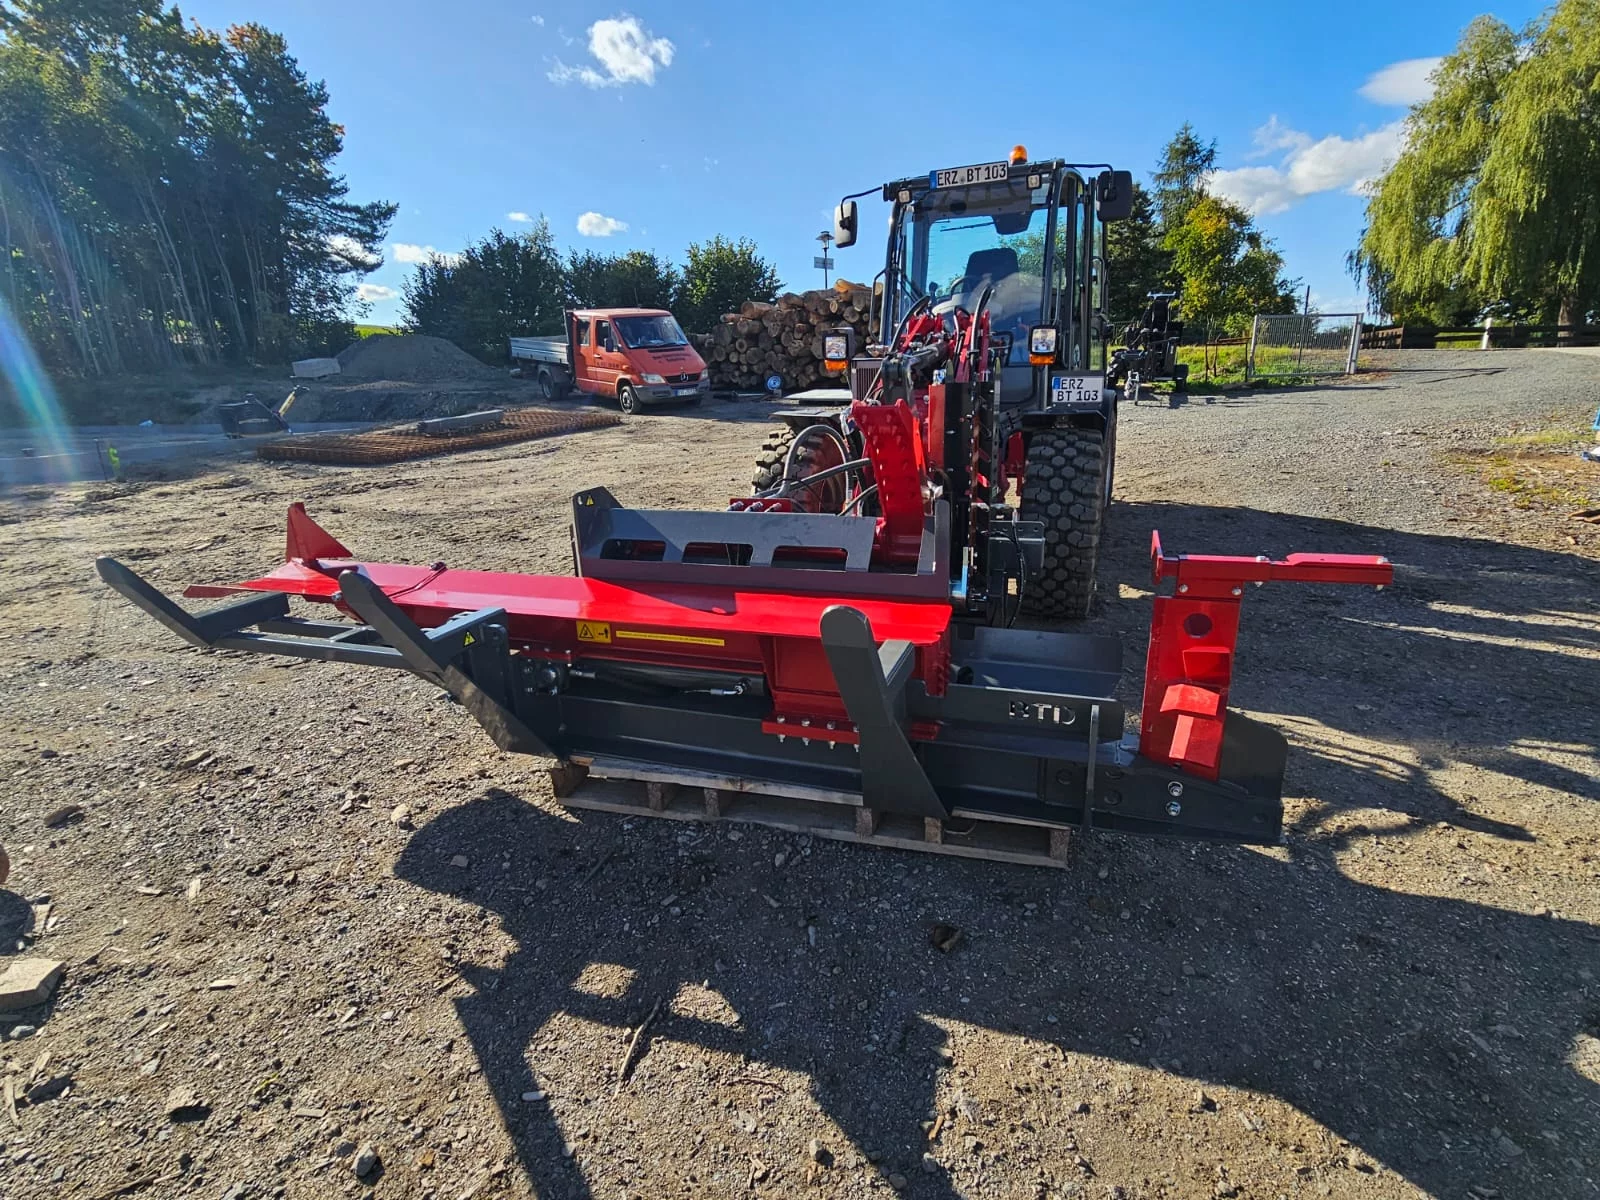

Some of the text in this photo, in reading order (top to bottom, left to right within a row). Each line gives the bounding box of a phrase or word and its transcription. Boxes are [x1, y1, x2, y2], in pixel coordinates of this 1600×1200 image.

[937, 163, 1006, 186] ERZ BT 103
[1061, 379, 1084, 390] ERZ
[1057, 390, 1098, 401] BT 103
